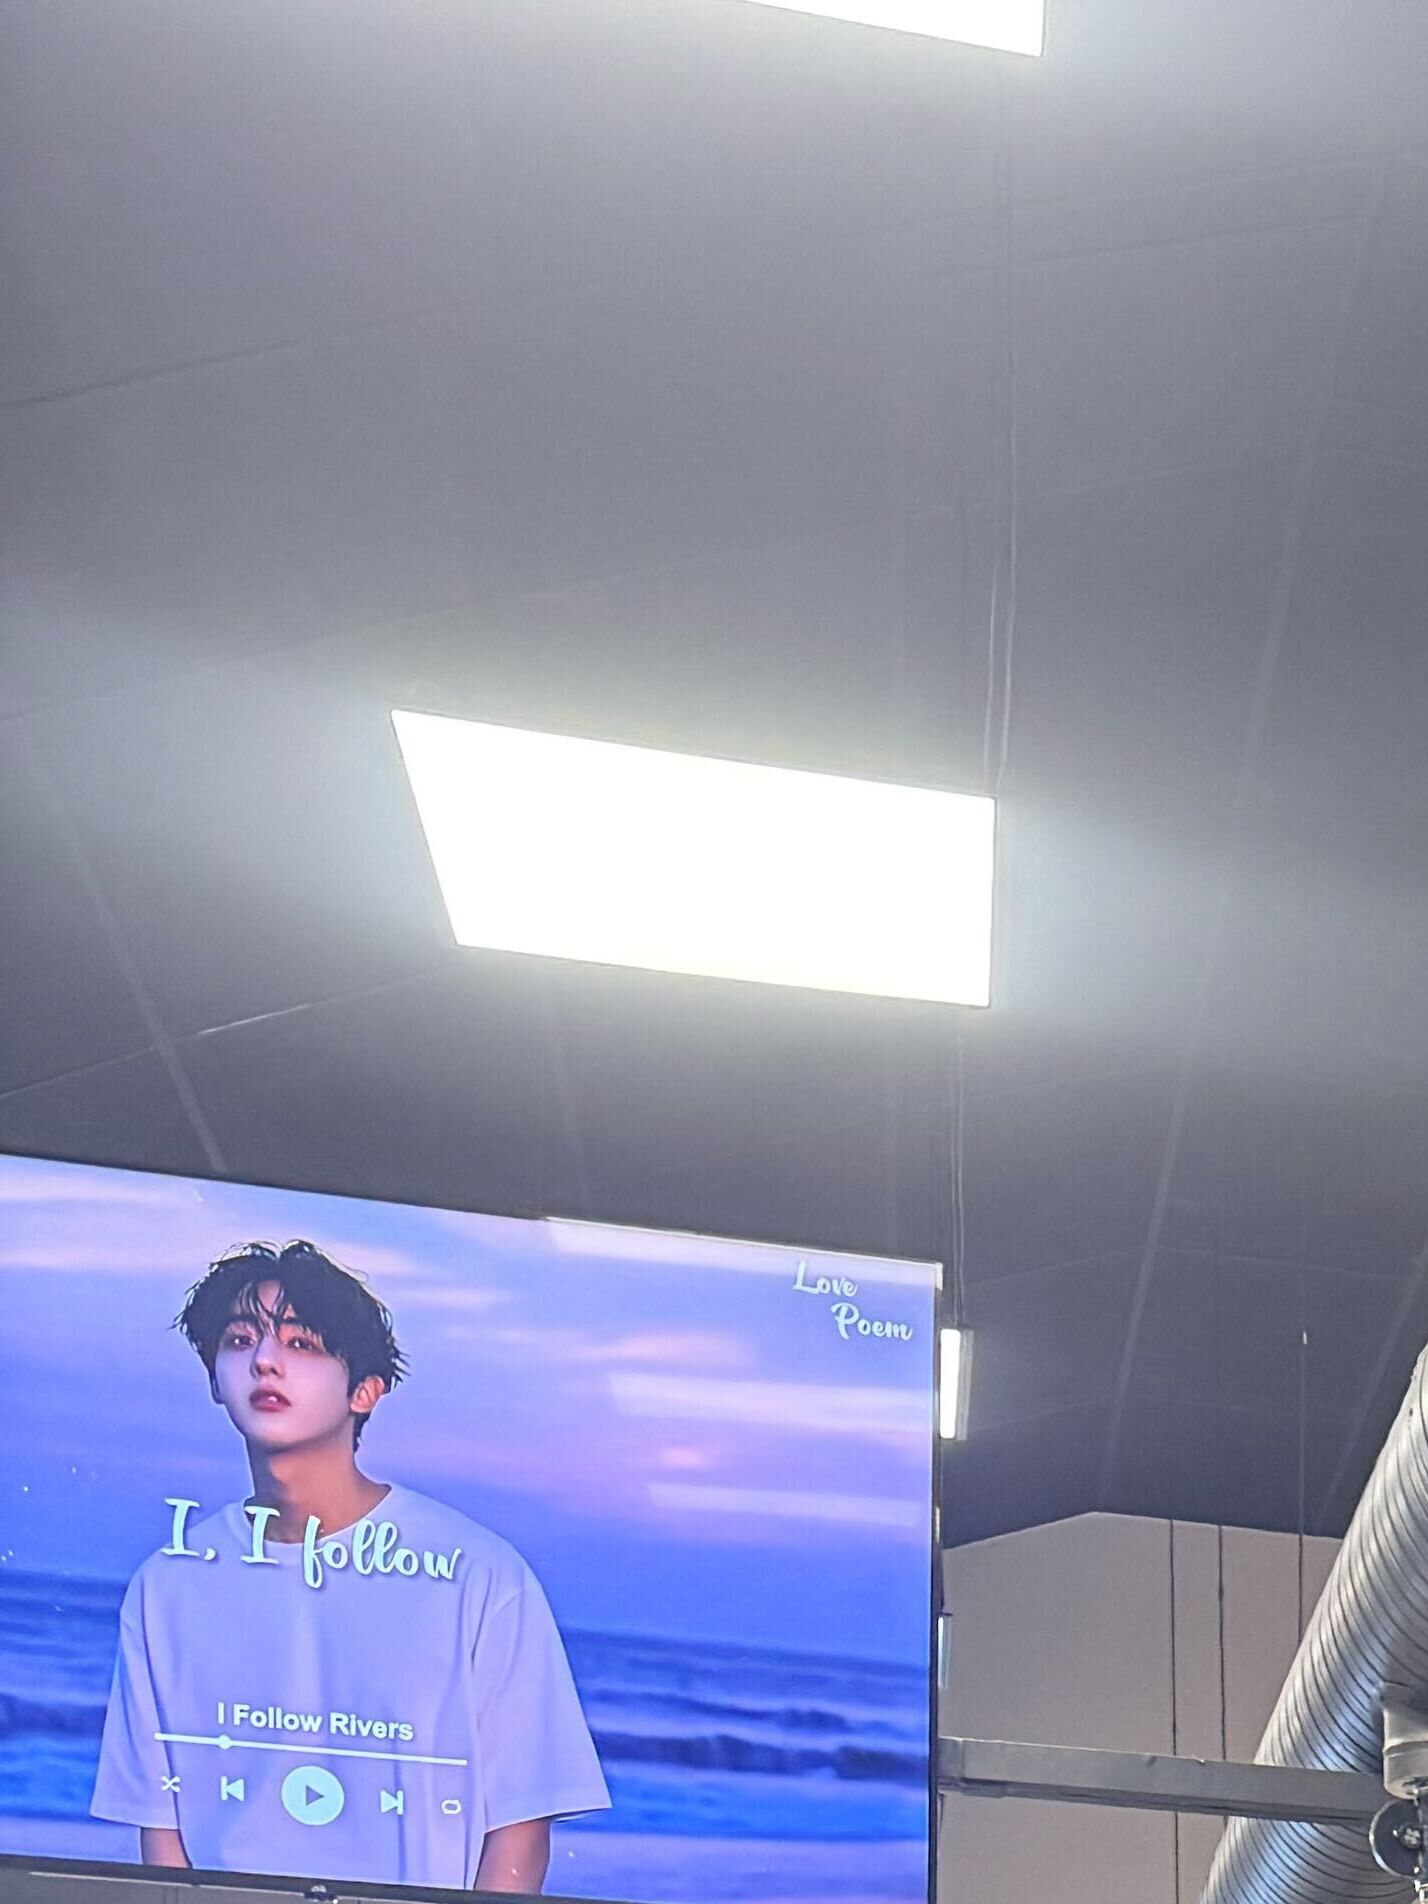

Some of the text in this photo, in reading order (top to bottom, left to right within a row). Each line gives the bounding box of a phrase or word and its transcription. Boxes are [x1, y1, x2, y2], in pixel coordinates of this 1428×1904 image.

[792, 1259, 858, 1297] Love
[831, 1302, 913, 1341] Poem
[161, 1498, 462, 1588] I, I follow
[217, 1702, 415, 1741] I Follow Rivers
